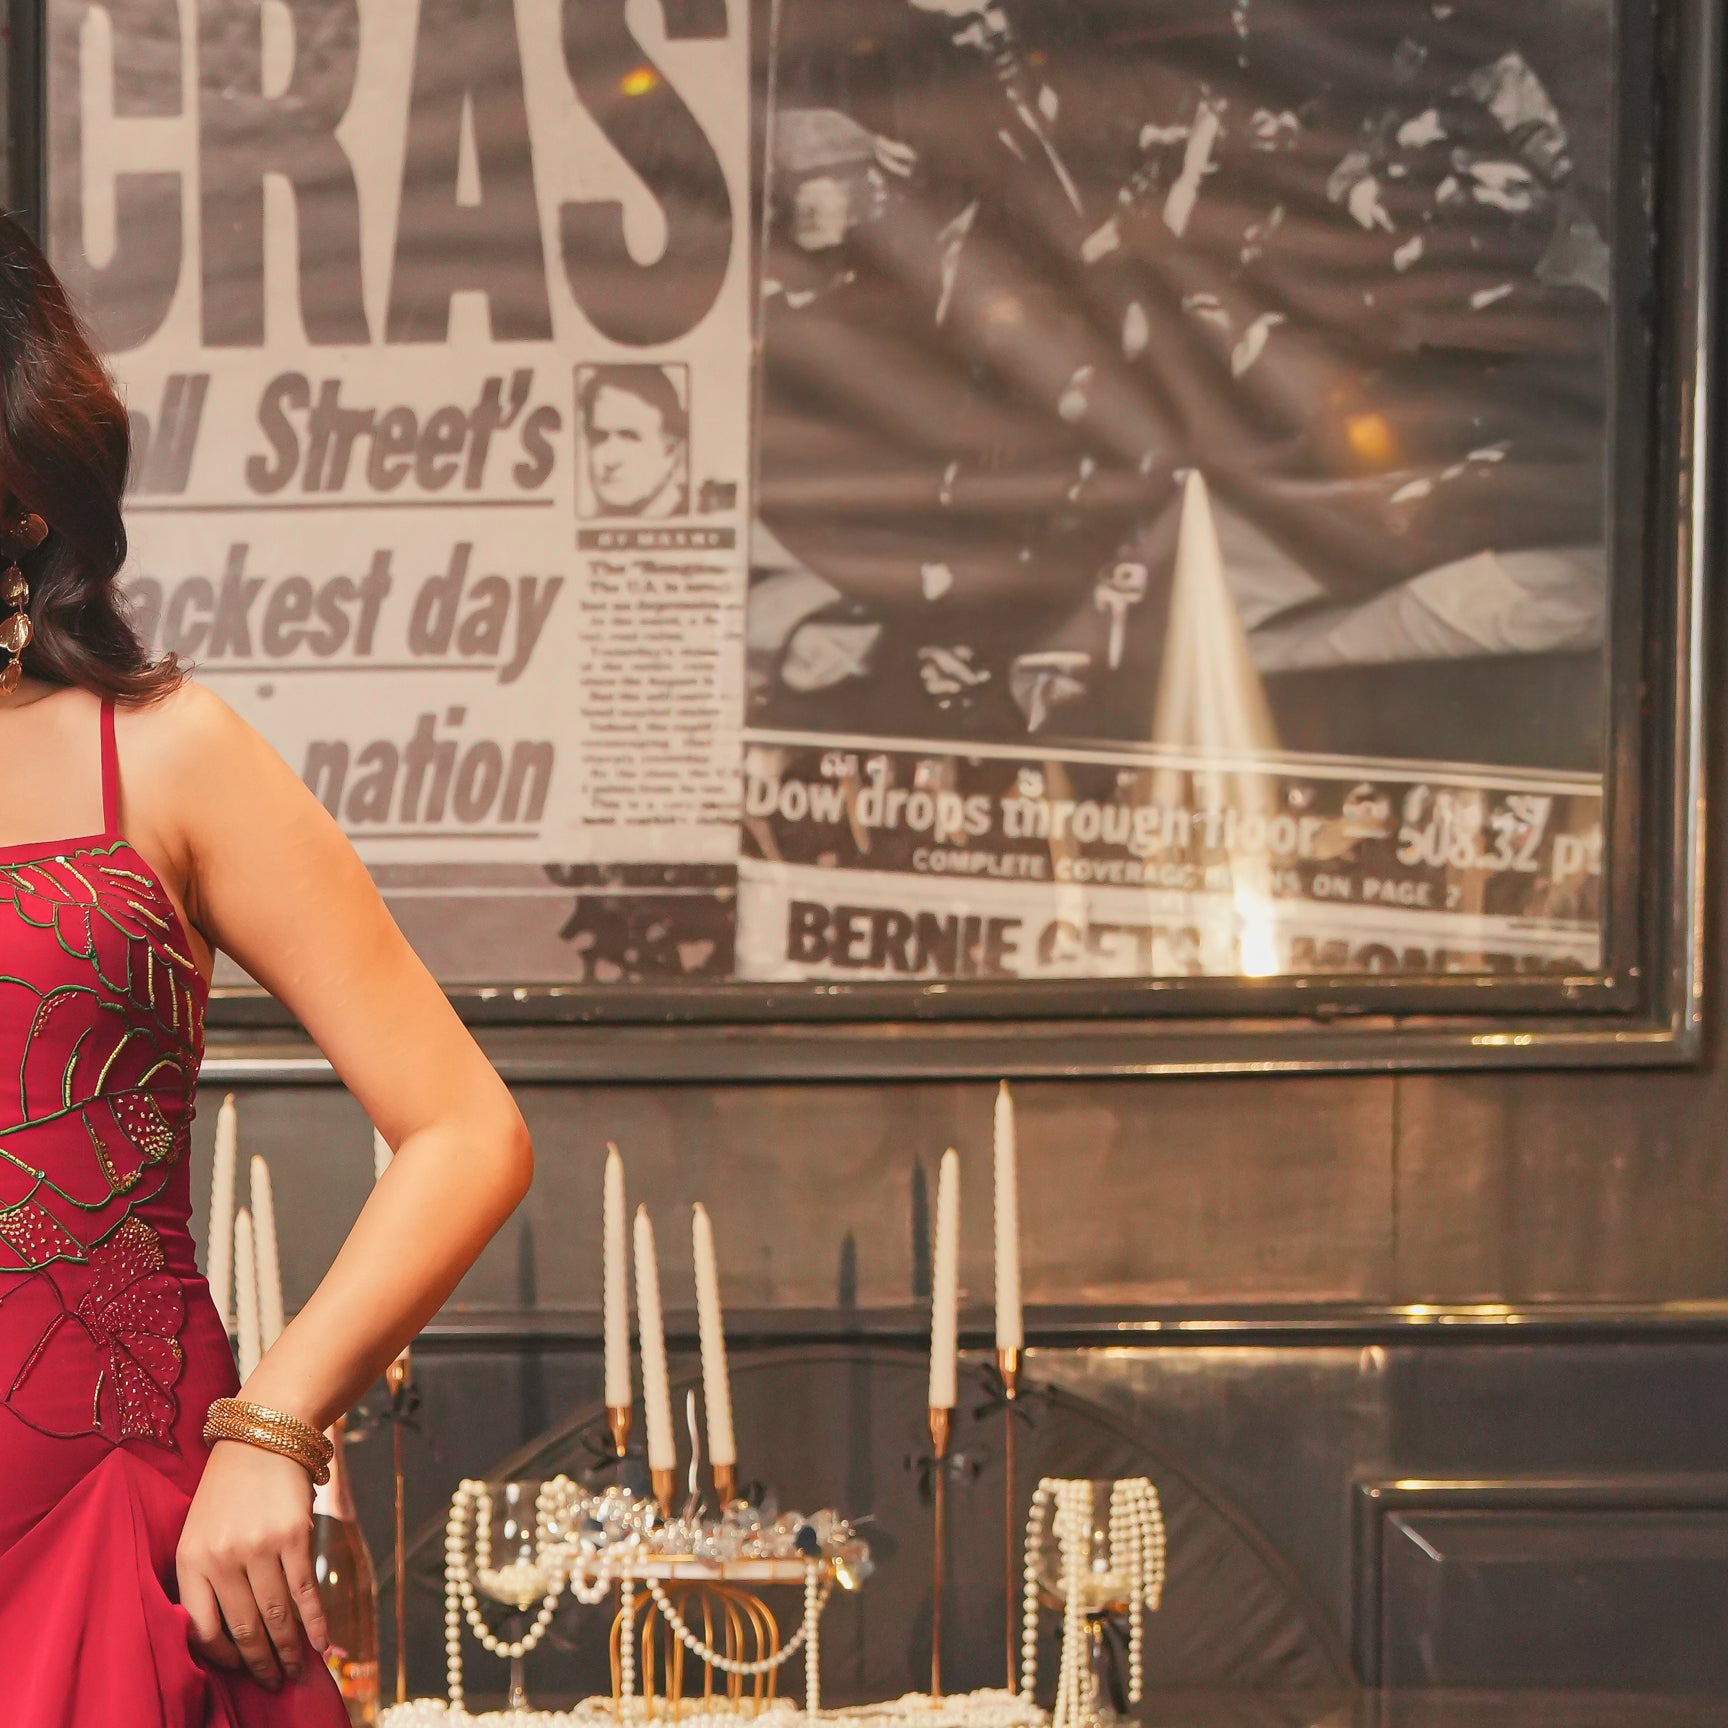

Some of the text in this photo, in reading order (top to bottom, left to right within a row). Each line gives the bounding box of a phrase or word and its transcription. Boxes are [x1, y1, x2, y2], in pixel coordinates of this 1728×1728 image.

[244, 368, 563, 495] Street's
[124, 541, 565, 686] ackest day
[303, 705, 555, 824] nation
[746, 765, 848, 823] Dow
[856, 760, 993, 843] drops
[1001, 788, 1190, 857] through
[1199, 798, 1325, 858] floor
[912, 849, 1046, 879] COMPLETE
[1056, 856, 1196, 888] COVERAGE
[1312, 873, 1352, 900] ON
[1361, 877, 1434, 907] PAGE
[787, 900, 1023, 978] BERNIE
